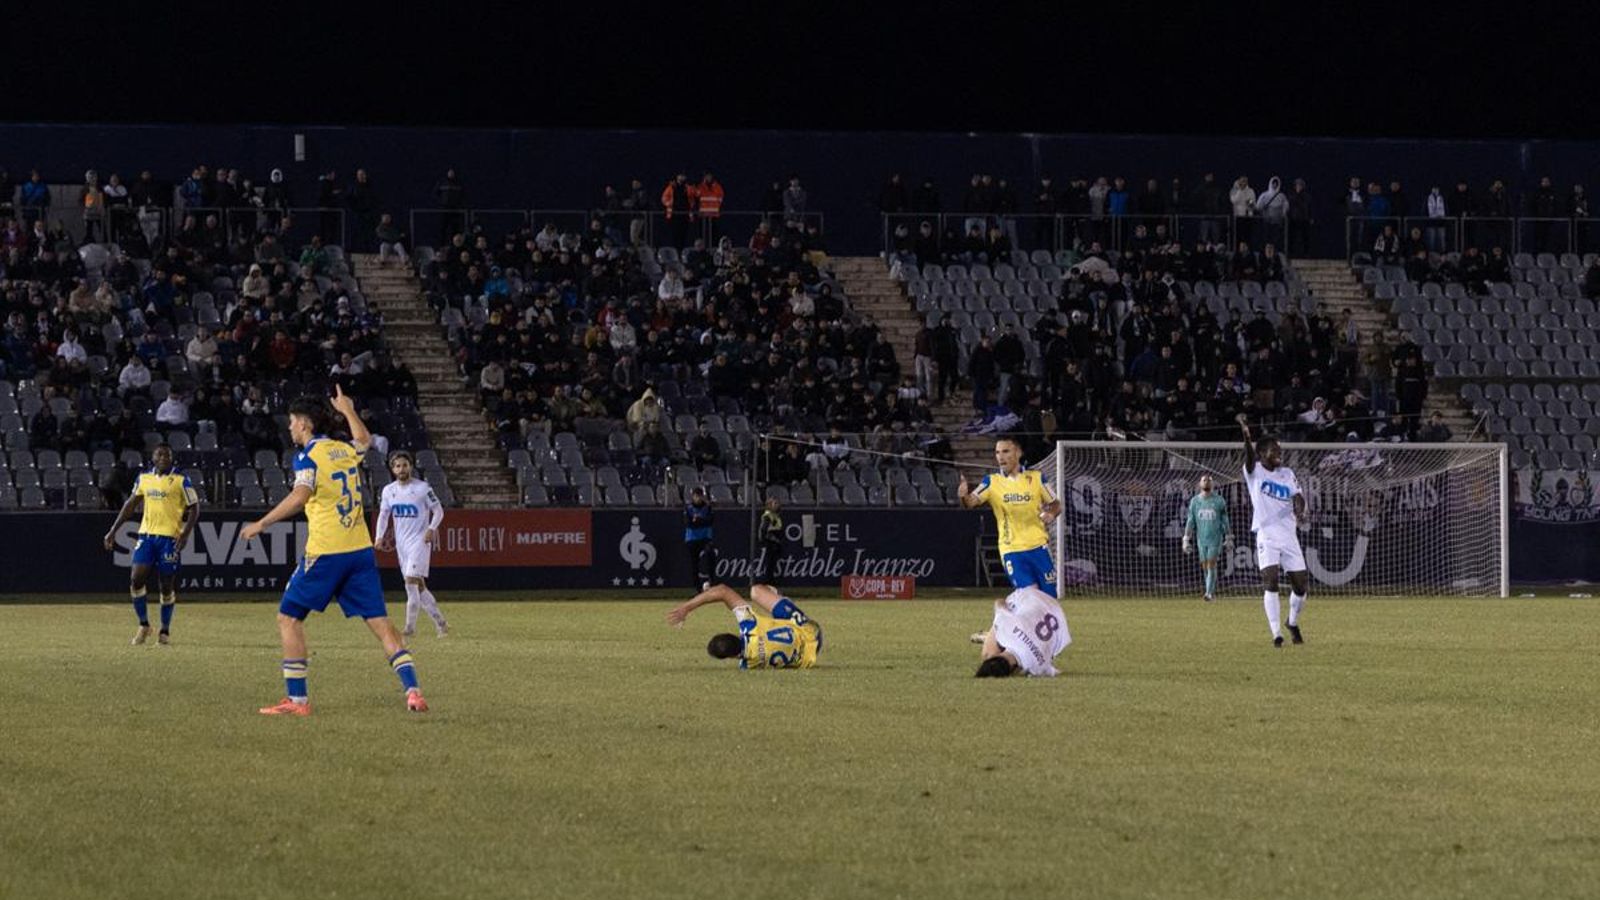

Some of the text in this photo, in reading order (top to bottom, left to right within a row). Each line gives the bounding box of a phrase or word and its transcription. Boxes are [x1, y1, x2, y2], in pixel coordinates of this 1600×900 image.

[113, 520, 307, 567] SLVAT
[447, 528, 472, 551] DEL
[479, 527, 505, 551] REY
[516, 532, 586, 545] MAPFRE
[698, 548, 935, 577] ondstable Iranzo
[180, 573, 278, 588] JAÉN FEST
[865, 579, 886, 593] COPA
[1035, 612, 1059, 642] 8
